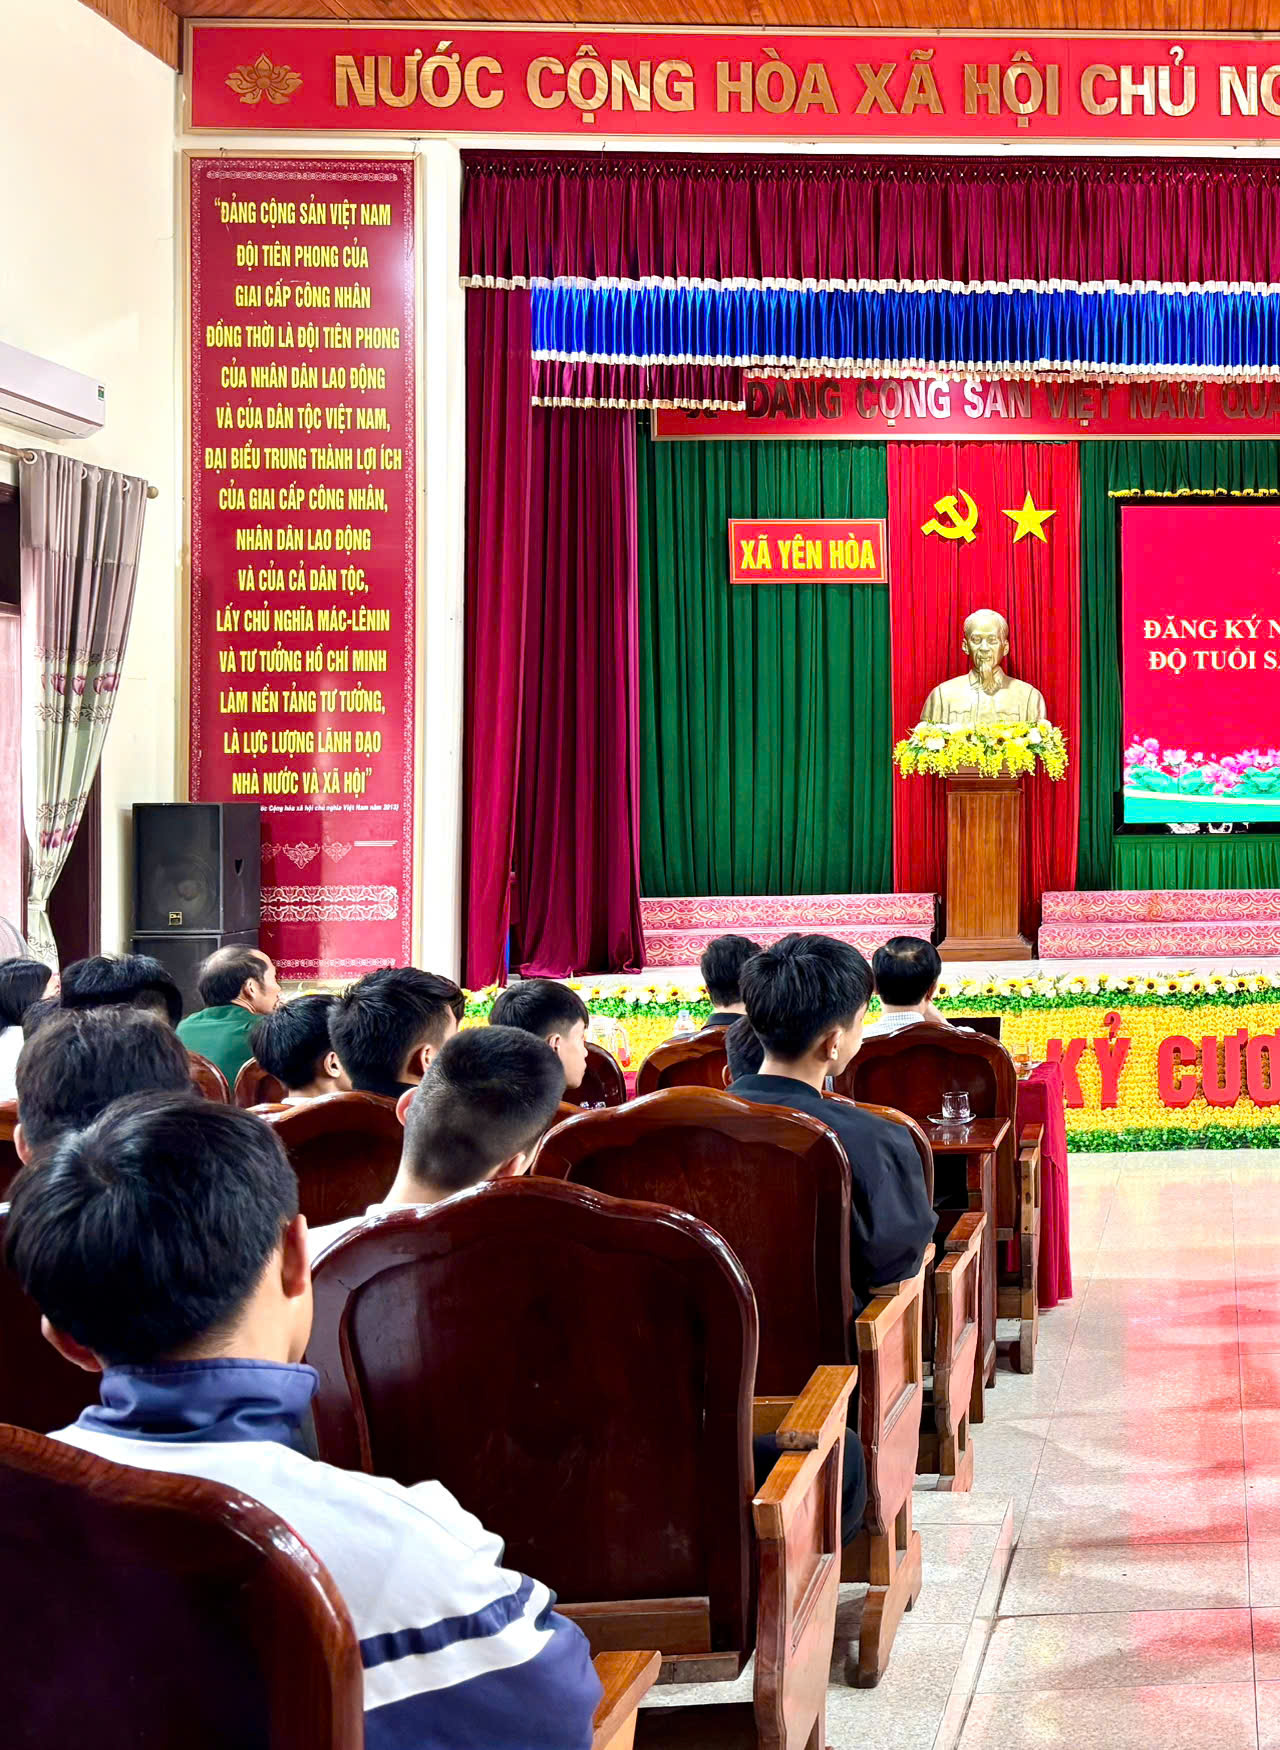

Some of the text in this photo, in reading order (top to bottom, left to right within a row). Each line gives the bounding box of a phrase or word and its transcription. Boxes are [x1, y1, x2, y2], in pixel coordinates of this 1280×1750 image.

[335, 40, 504, 109] NƯỚC
[526, 45, 695, 123] CỘNG
[716, 47, 838, 114] HÒA
[855, 48, 943, 114] XÃ
[965, 50, 1059, 127] HỘI
[1081, 46, 1196, 117] CHỦ
[260, 198, 296, 228] CỘNG
[300, 194, 326, 224] SẢN
[330, 199, 357, 230] VIỆT
[361, 204, 390, 225] NAM
[236, 237, 368, 271] ĐỘI TIÊN PHONG CỦA
[235, 278, 370, 308] GIAI CẤP CÔNG NHÂN
[206, 318, 399, 352] ĐỒNG THỜI LÀ ĐỘI TIÊN PHONG
[205, 439, 402, 475] ĐẠI BIỂU TRUNG THÀNH LỢI ÍCH
[235, 524, 371, 555] NHÂN DÂN LAO ĐỘNG
[740, 532, 877, 570] XÃ YÊN HÒA
[216, 600, 390, 632] LẤY CHỦ NGHĨA MÁC-LÊNIN
[1143, 615, 1218, 639] ĐĂNG
[1224, 613, 1262, 639] KÝ
[1148, 647, 1187, 675] ĐỘ
[1192, 647, 1257, 671] TUỔI
[220, 681, 385, 715] LÀM NỀN TẢNG TƯ TƯỞNG,
[232, 768, 260, 794] NHÀ
[262, 766, 298, 794] NƯỚC
[302, 770, 320, 794] VÀ
[322, 767, 340, 793] XÃ
